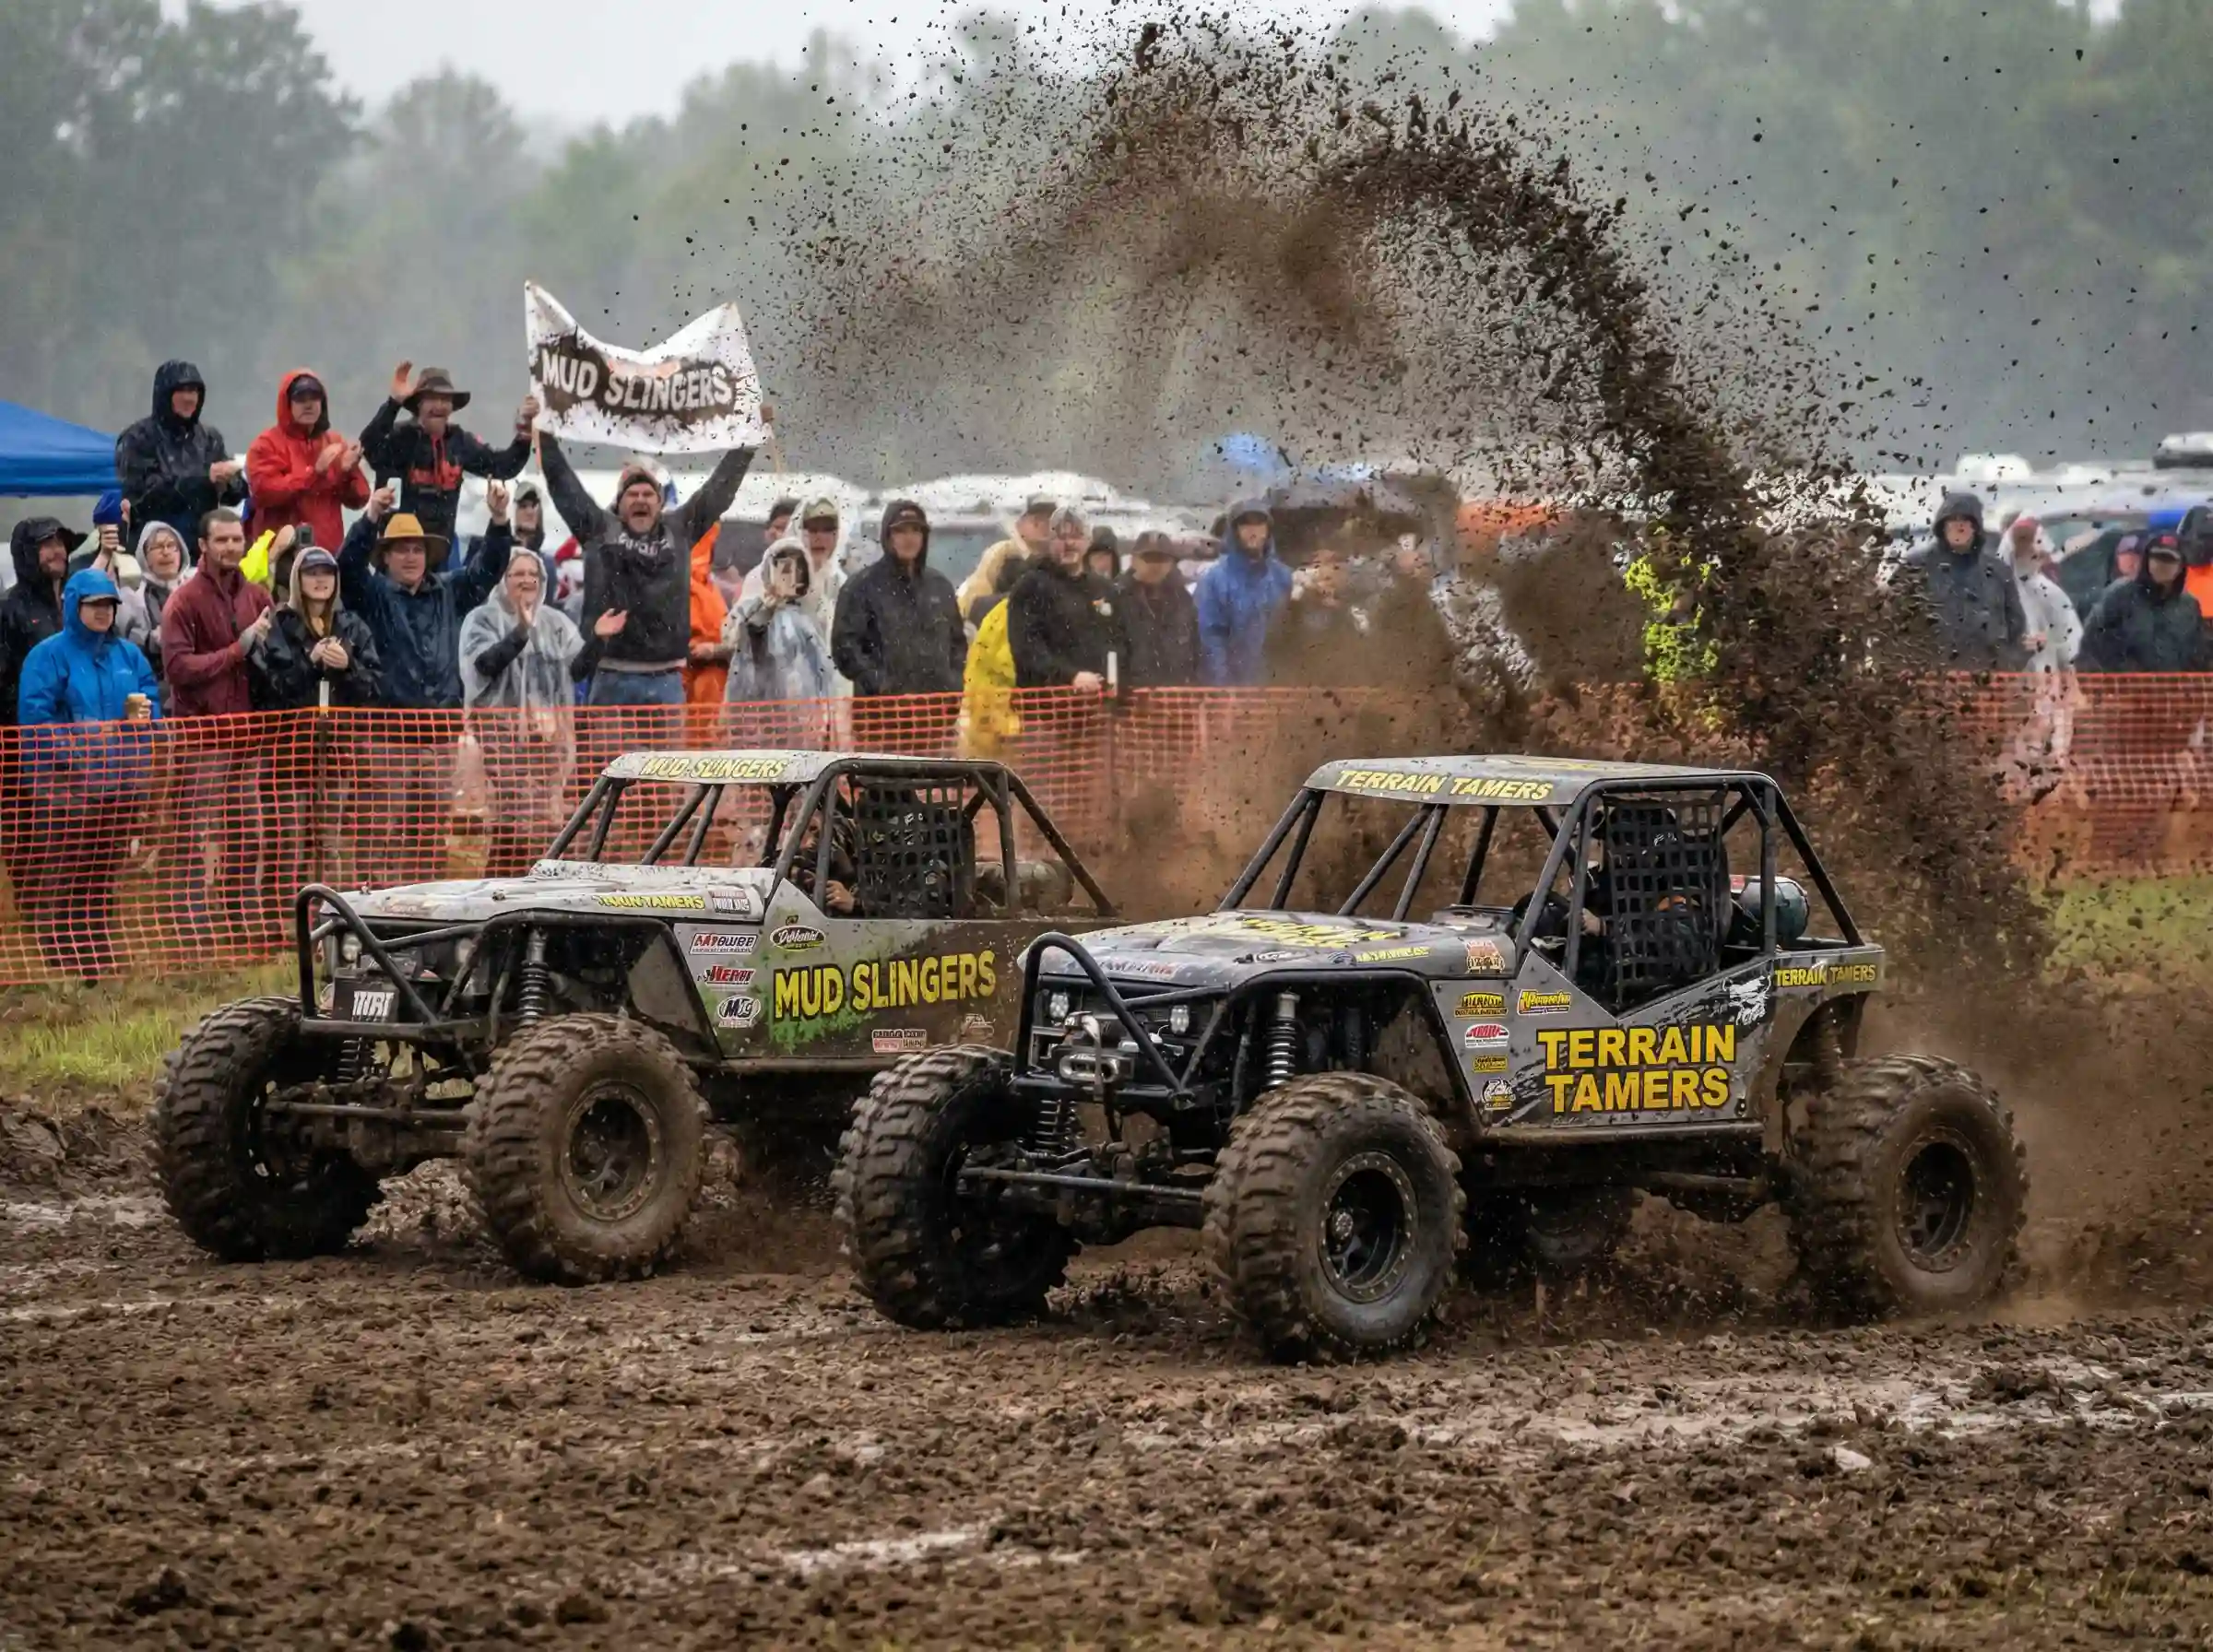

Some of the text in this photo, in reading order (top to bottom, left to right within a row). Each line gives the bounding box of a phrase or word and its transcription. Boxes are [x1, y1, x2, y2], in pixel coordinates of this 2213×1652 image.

[540, 349, 732, 411] MUD SLINGERS
[639, 756, 690, 777] MUD
[1335, 769, 1555, 800] TERRAIN TAMERS
[774, 949, 998, 1021] MUD SLINGERS
[1536, 1023, 1735, 1069] TERRAIN
[1544, 1067, 1732, 1114] TAMERS
